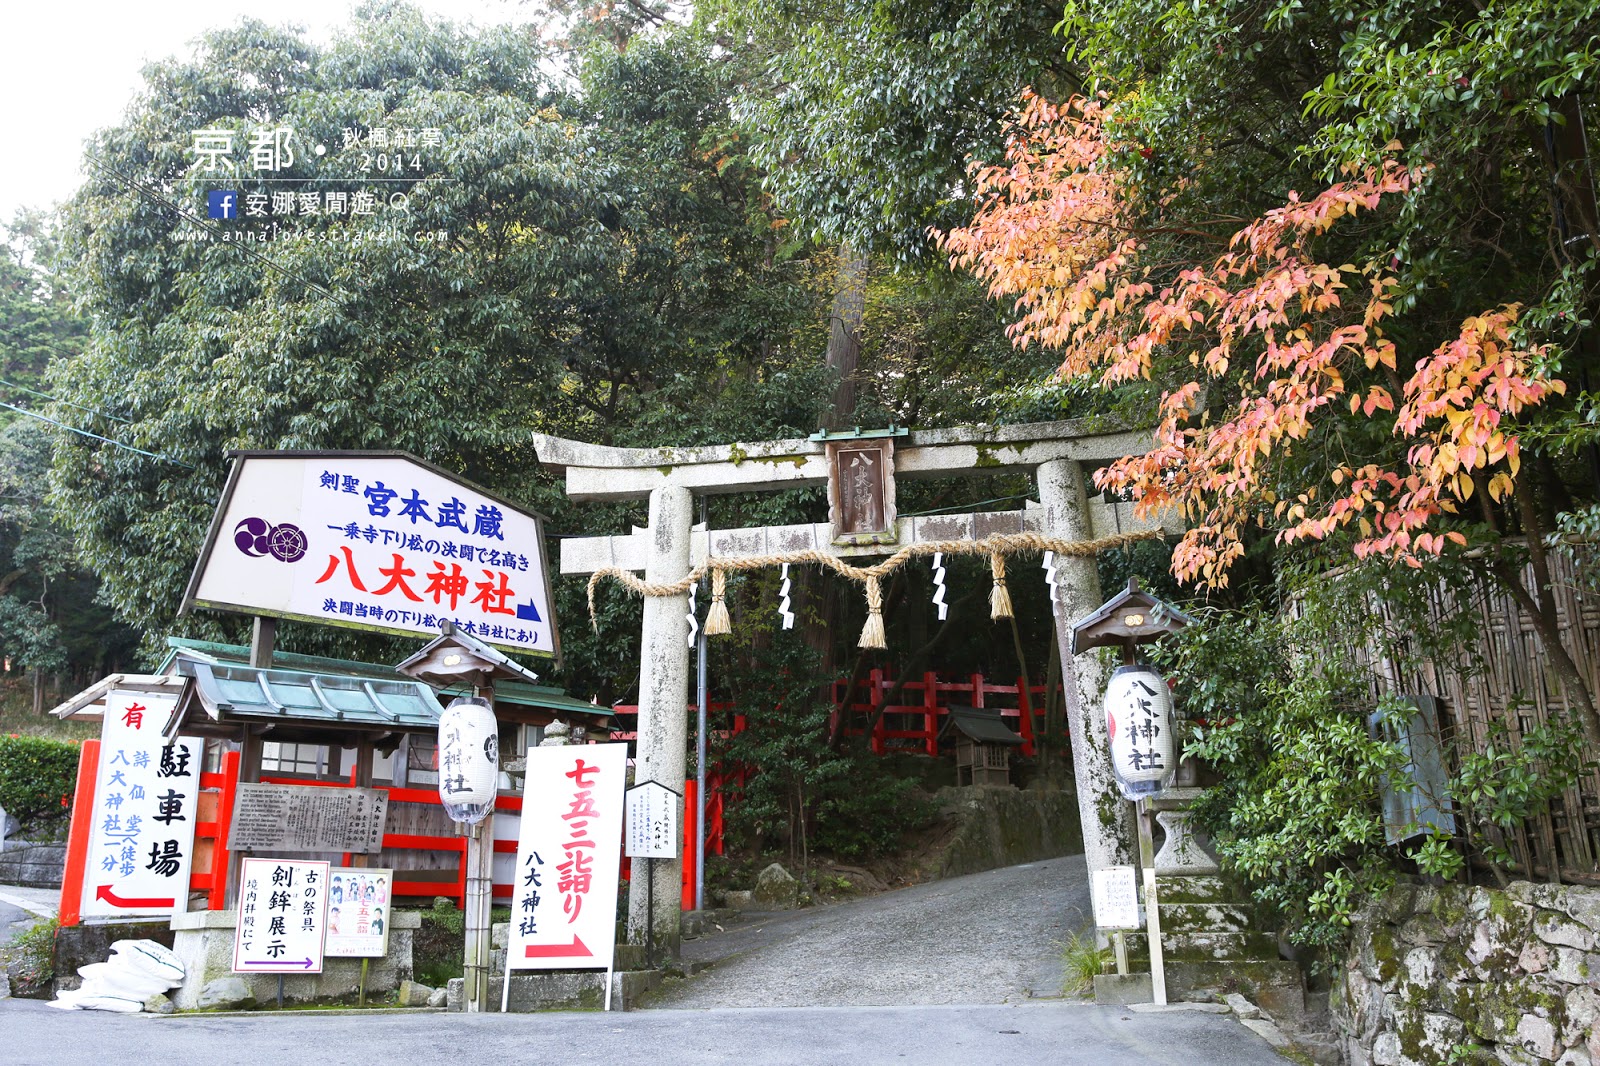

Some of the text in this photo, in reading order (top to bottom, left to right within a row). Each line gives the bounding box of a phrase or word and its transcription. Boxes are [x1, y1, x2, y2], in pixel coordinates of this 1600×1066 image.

[319, 470, 505, 541] 剣聖 宮本武蔵
[315, 546, 516, 616] 八大神社
[327, 521, 530, 572] 一乗寺下り松の決闘で名高き
[145, 744, 191, 878] 駐車場
[556, 759, 600, 924] 七五三詣り
[242, 879, 258, 951] 境内拝殿にて
[267, 866, 294, 958] 剣鉾展示
[301, 870, 318, 932] 古の祭具
[519, 851, 544, 937] 八大神社
